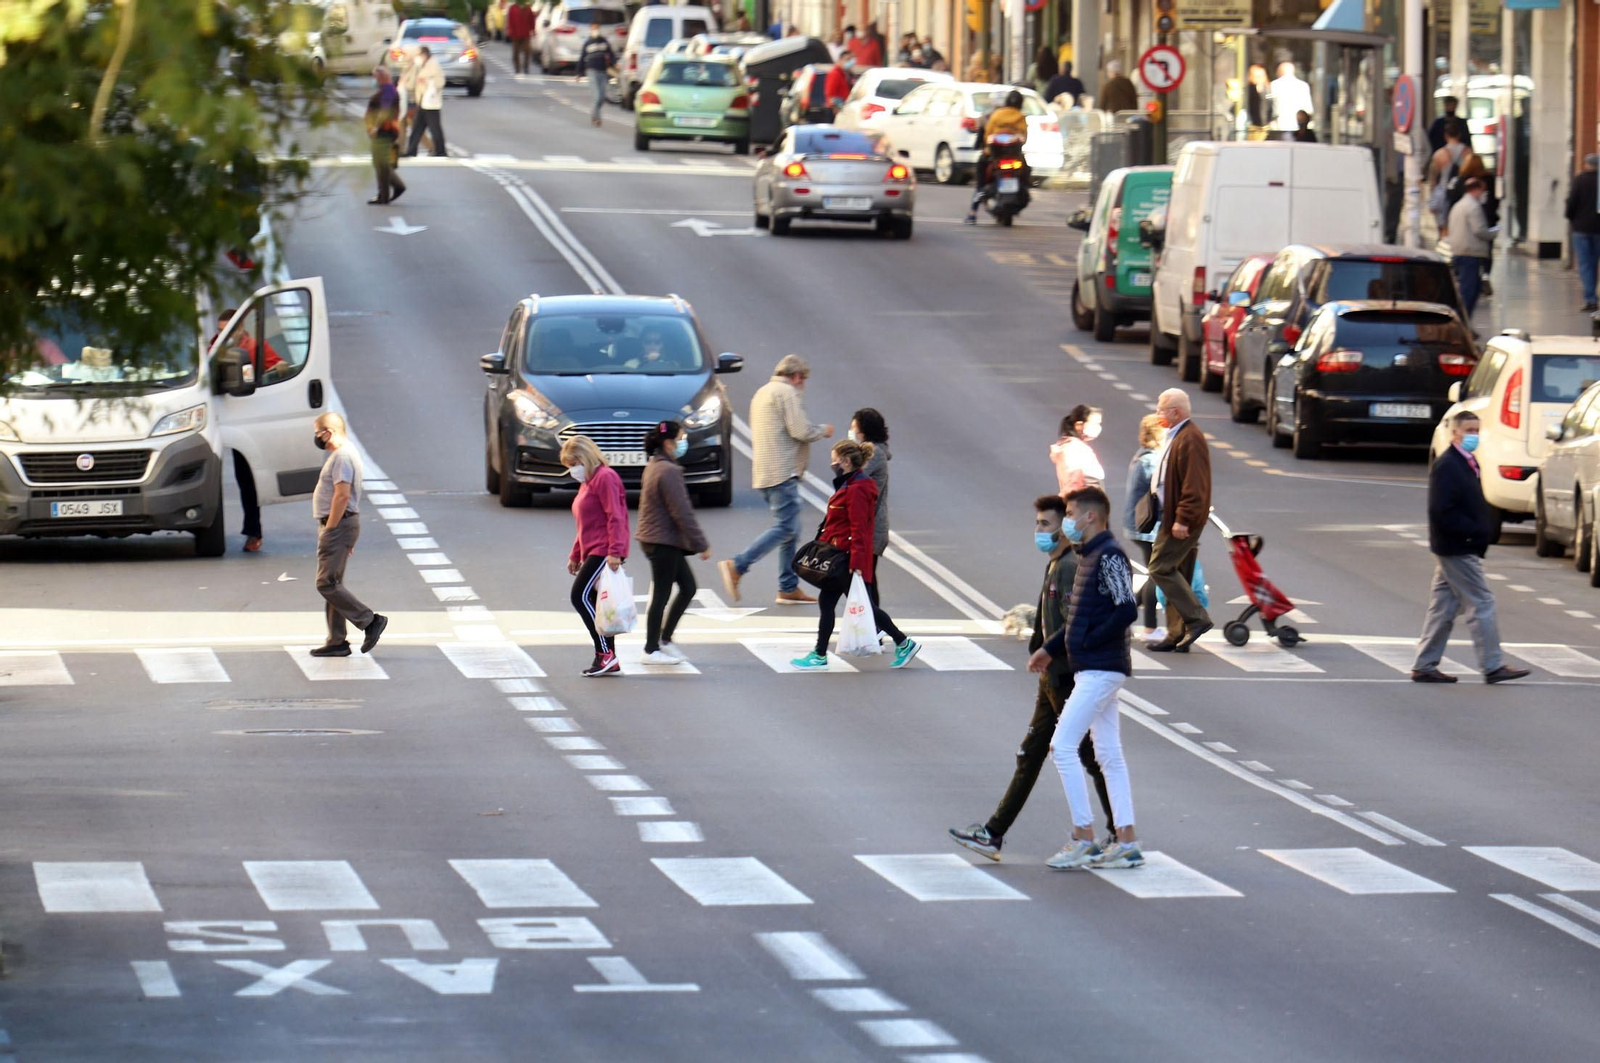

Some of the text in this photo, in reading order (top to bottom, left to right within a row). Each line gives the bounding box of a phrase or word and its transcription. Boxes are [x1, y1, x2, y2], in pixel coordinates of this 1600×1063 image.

[604, 453, 645, 464] 912 LF
[60, 502, 119, 515] 0549 JSX
[797, 555, 831, 571] ADAS
[163, 917, 614, 953] BUS
[129, 956, 702, 998] TAXI
